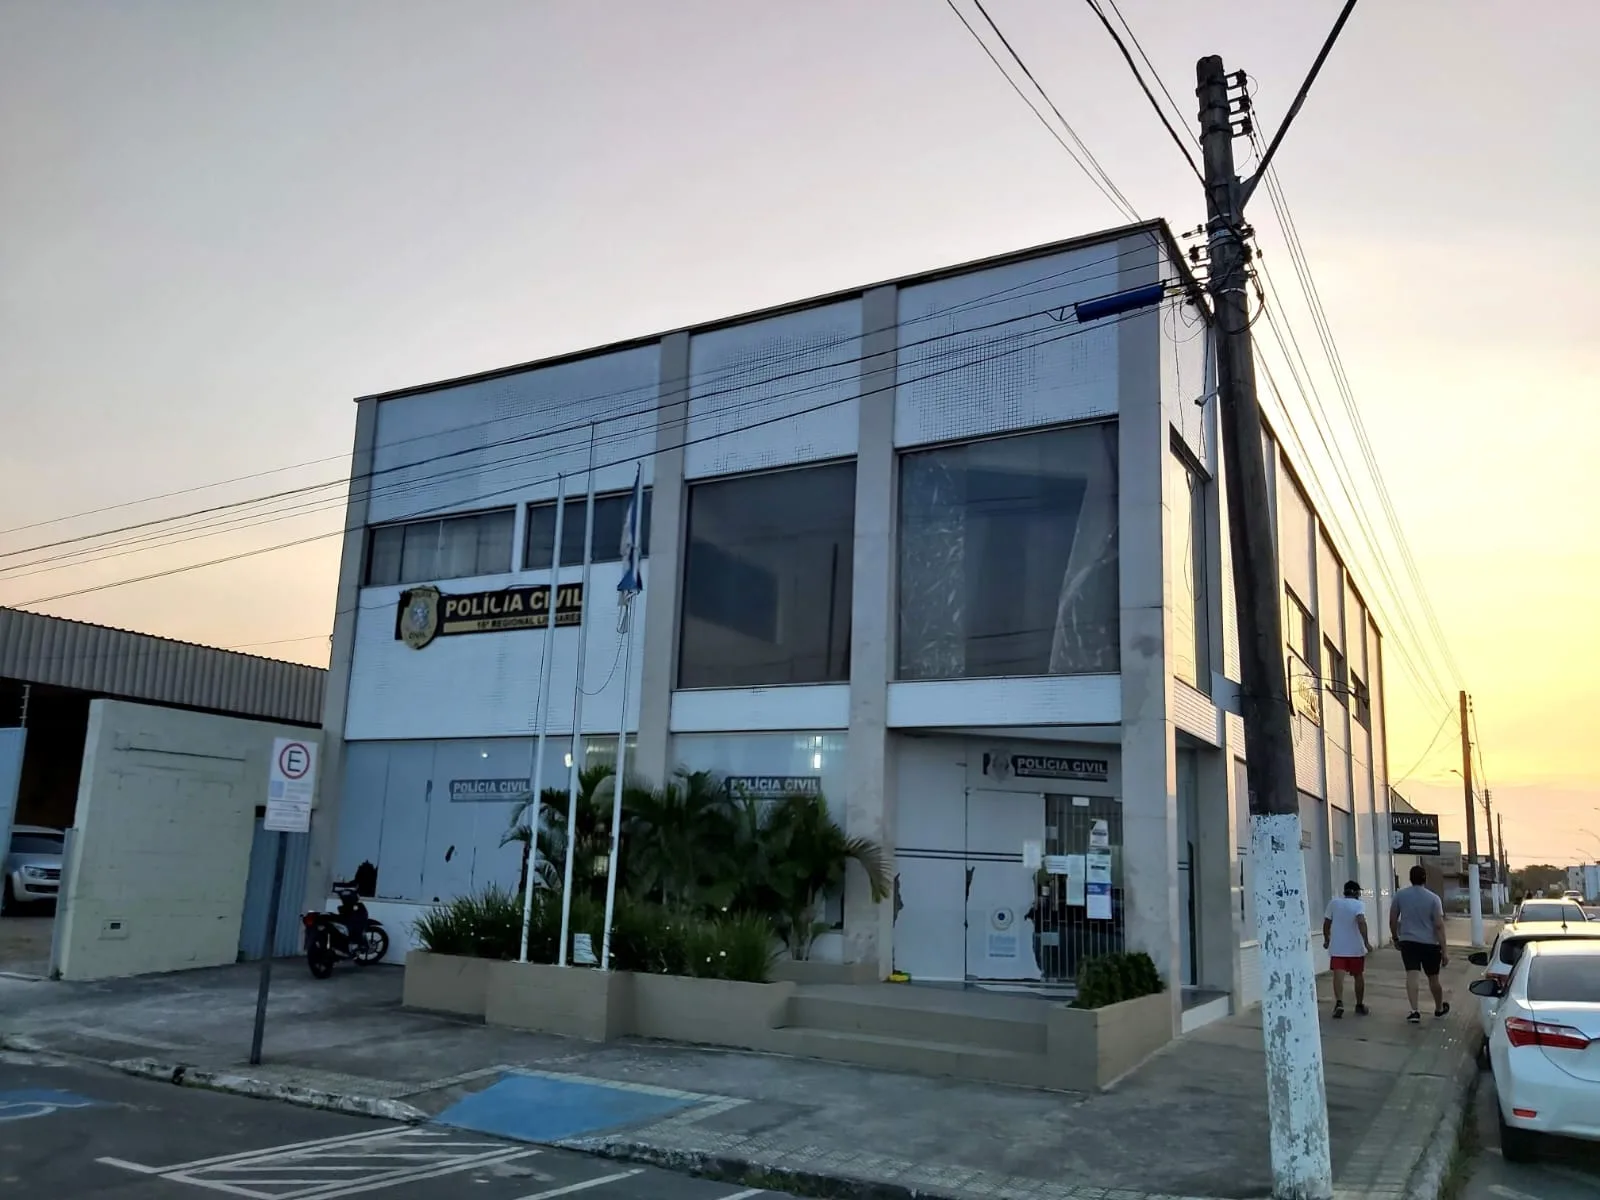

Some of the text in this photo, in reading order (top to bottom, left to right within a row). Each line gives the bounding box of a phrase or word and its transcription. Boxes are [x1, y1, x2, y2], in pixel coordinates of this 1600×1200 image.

[445, 588, 583, 617] POLÍCIA CIVIL
[492, 617, 535, 628] REGIONAL
[288, 750, 302, 772] E
[1018, 756, 1106, 773] POLÍCIA CIVIL
[454, 780, 528, 793] POLÍCIA CIVIL
[785, 779, 818, 789] CIVIL
[1392, 816, 1434, 826] DVOCACIA
